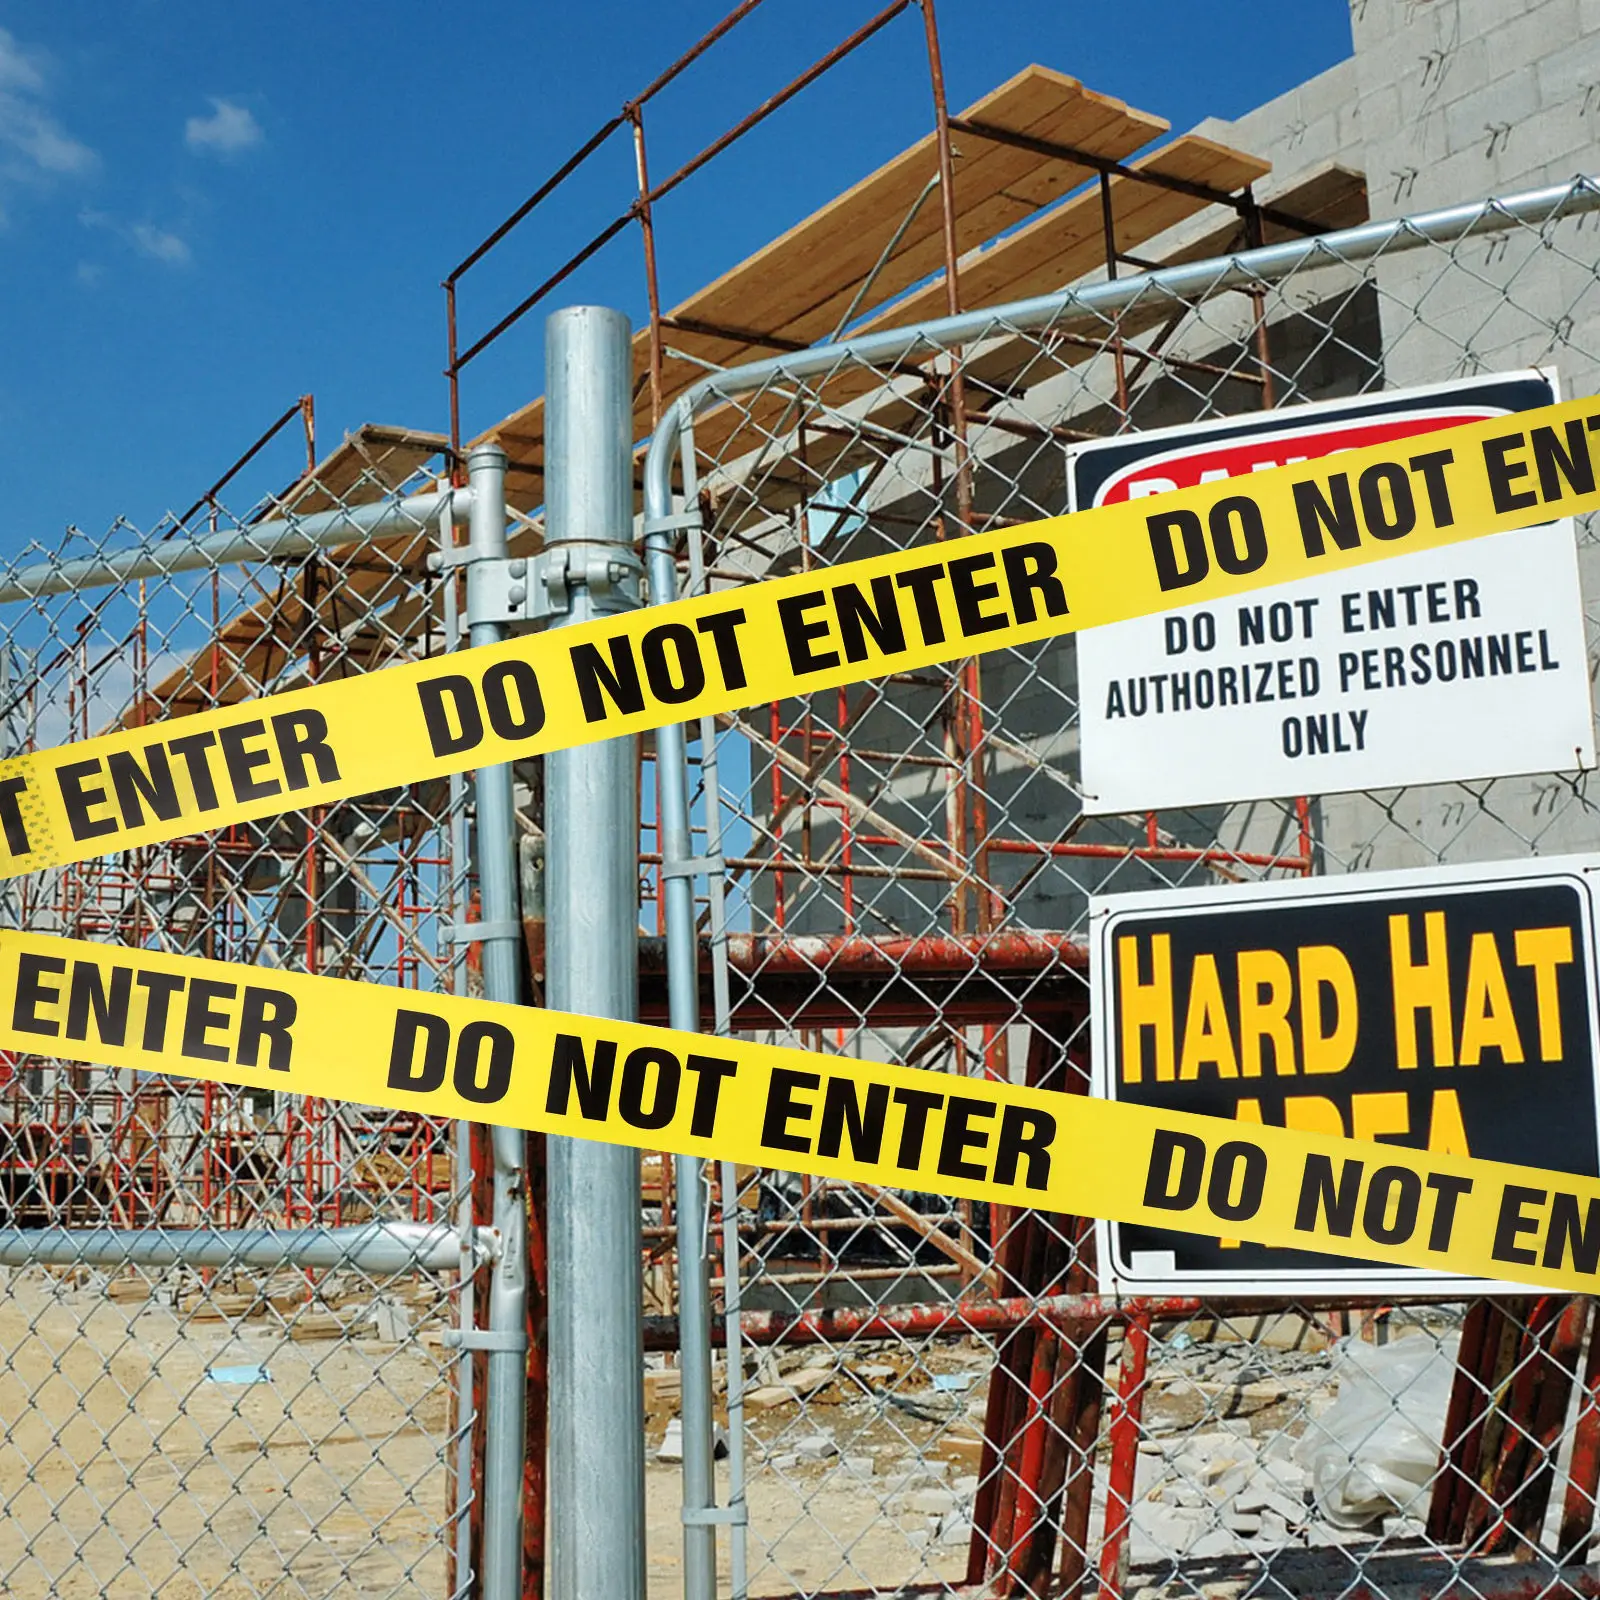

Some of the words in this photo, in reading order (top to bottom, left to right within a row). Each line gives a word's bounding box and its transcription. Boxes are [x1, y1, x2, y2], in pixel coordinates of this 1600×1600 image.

[55, 708, 341, 842] ENTER
[417, 660, 546, 758] DO
[570, 607, 748, 724] NOT
[776, 541, 1070, 677] ENTER
[1145, 495, 1269, 592] DO
[1291, 448, 1455, 559] NOT
[1481, 414, 1600, 515] EN
[1164, 611, 1216, 656] DO
[1238, 598, 1319, 647] NOT
[1341, 578, 1481, 634] ENTER
[1105, 656, 1320, 720] AUTHORIZED
[1338, 629, 1560, 694] PERSONNEL
[1282, 709, 1368, 759] ONLY
[12, 952, 298, 1073] ENTER
[387, 1008, 515, 1104] DO
[546, 1033, 738, 1139] NOT
[760, 1067, 1057, 1191] ENTER
[1142, 1128, 1268, 1222] DO
[1294, 1153, 1474, 1253] NOT
